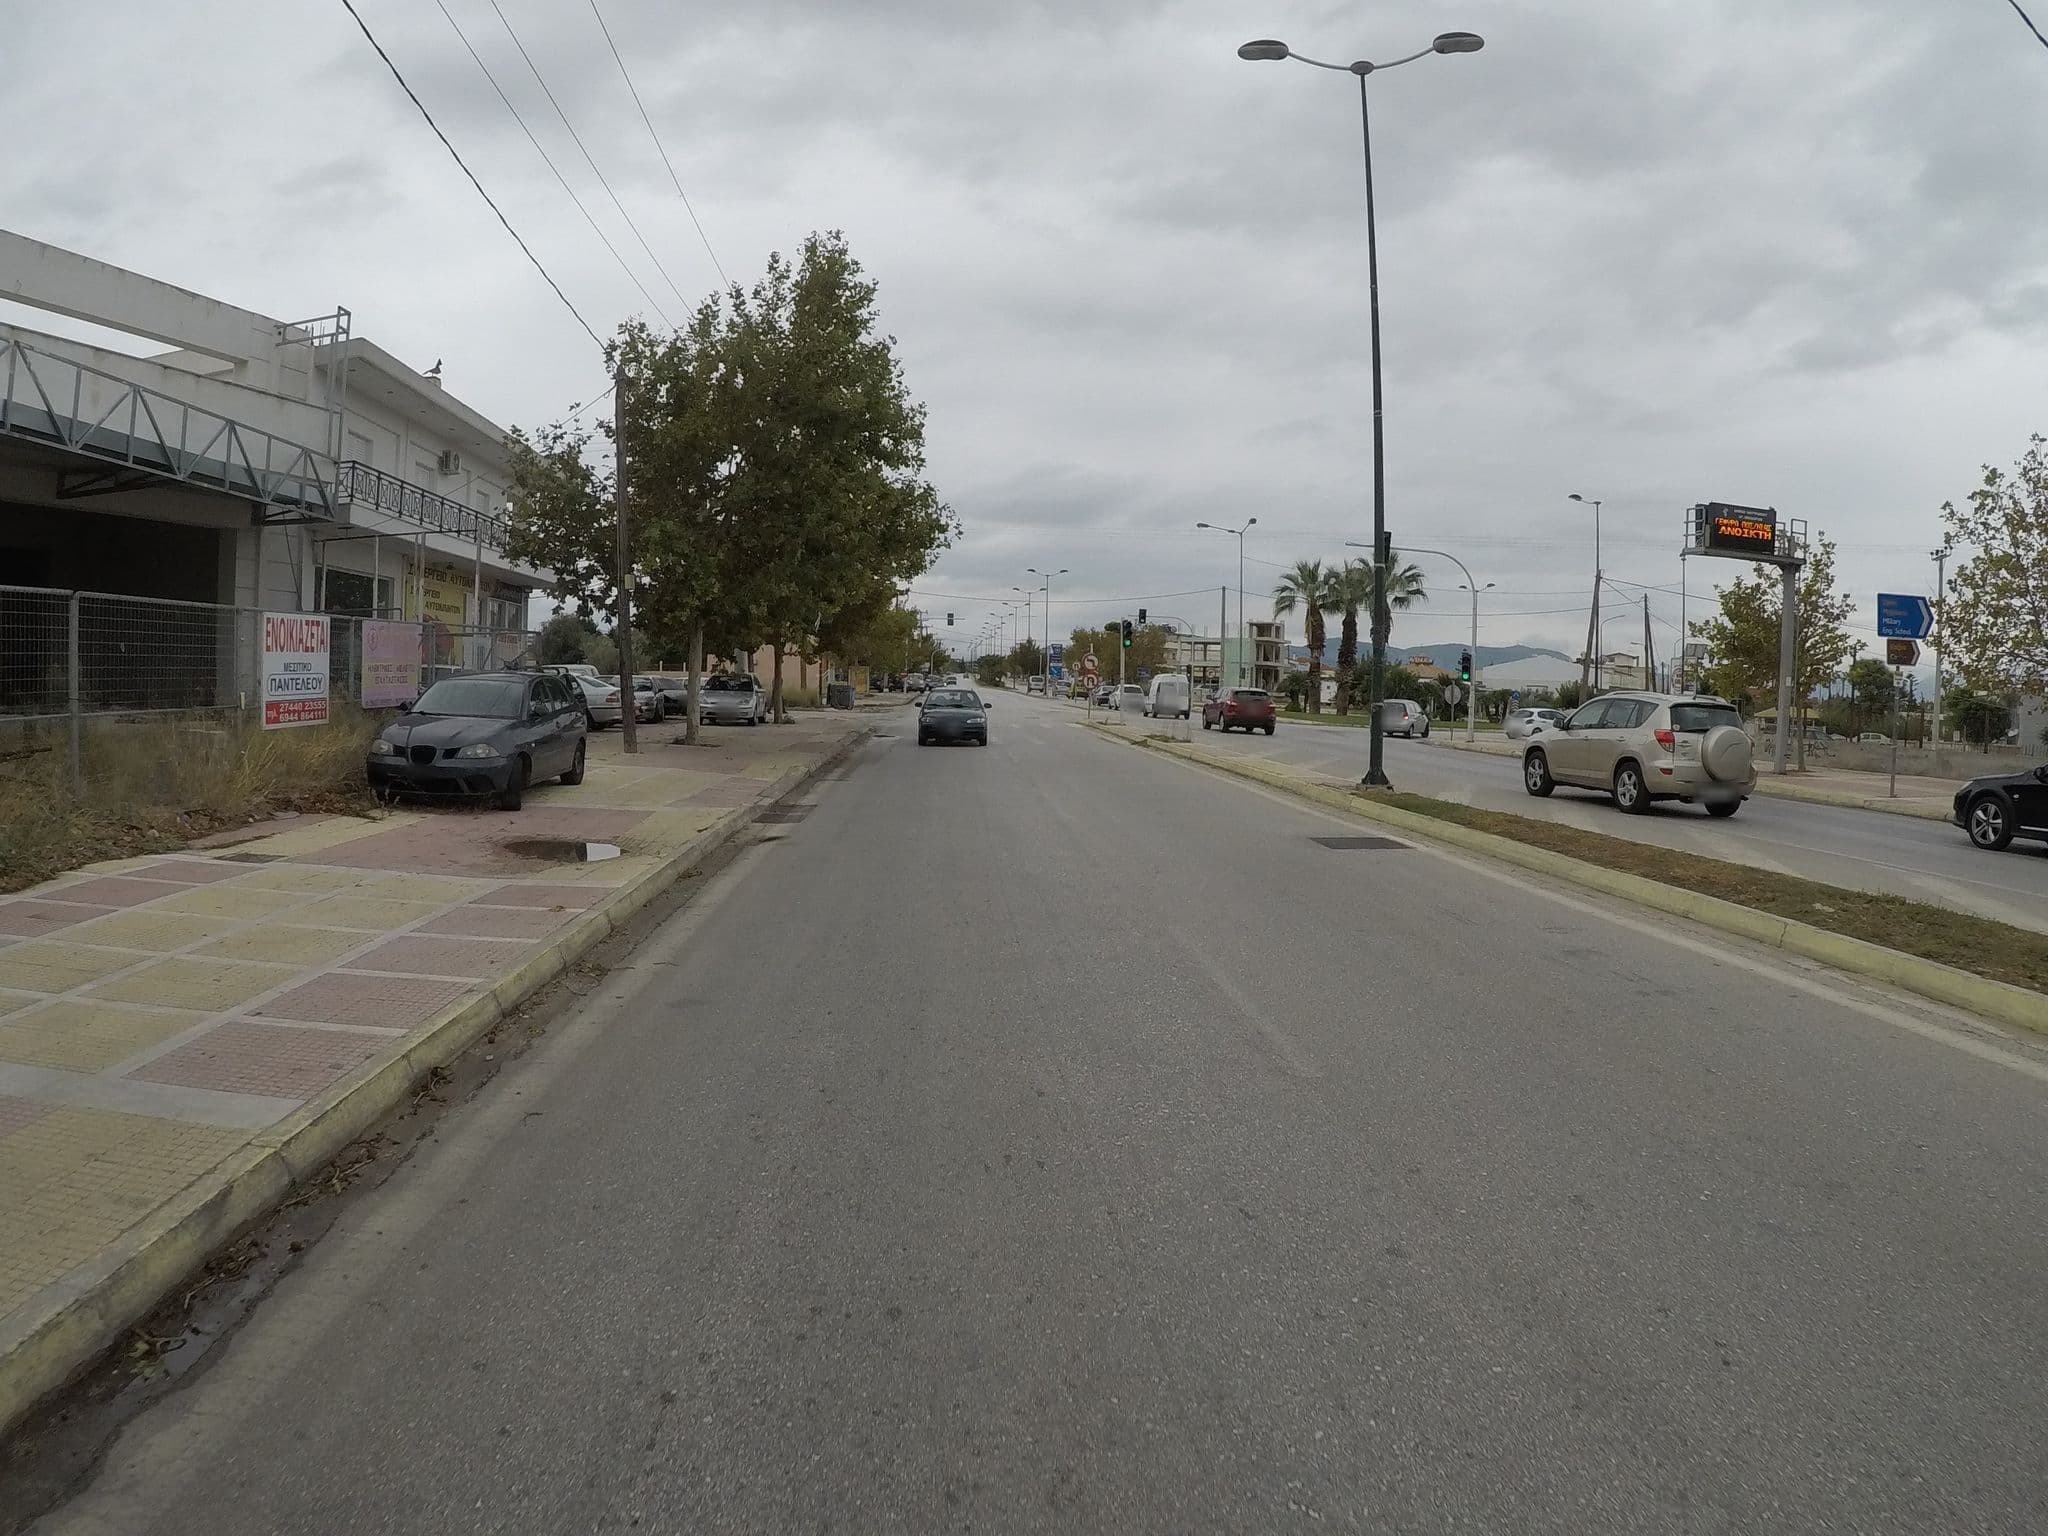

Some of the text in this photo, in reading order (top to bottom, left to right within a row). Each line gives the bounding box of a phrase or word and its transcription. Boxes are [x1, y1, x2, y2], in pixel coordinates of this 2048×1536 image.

[1718, 526, 1771, 540] ΑΝΟΙΚΤΗ
[265, 617, 328, 652] ΕΝΟΙΚΙΑΖΕΤΑΙ
[270, 677, 323, 691] ΠΑΝΤΕΛΕΟΥ
[279, 700, 326, 712] 27440 23555
[279, 712, 299, 722] 6944
